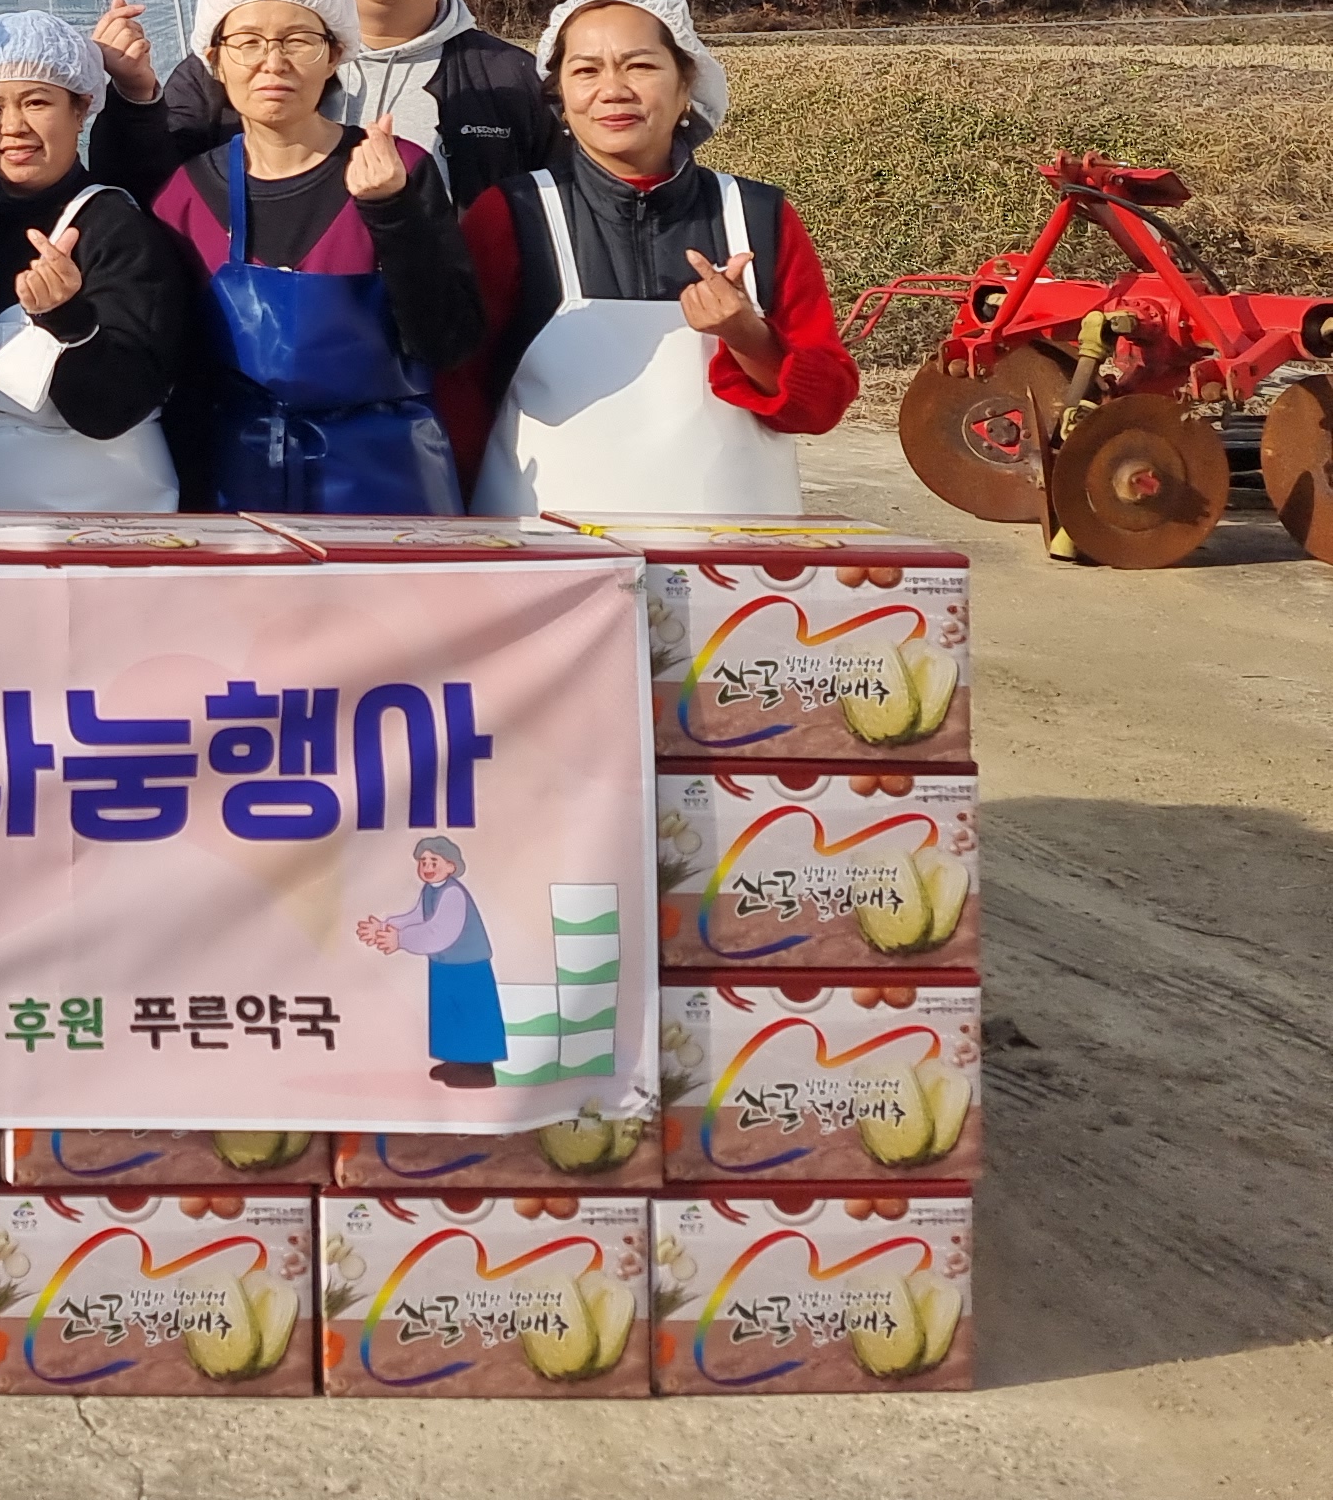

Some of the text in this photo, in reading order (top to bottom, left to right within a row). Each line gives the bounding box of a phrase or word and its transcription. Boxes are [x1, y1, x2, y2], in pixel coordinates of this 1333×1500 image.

[712, 659, 891, 713] 산골 절임배추
[731, 870, 905, 923] 산골 절임배추
[5, 995, 341, 1052] 후원 푸른약국
[733, 1082, 907, 1135] 산골 절임배추
[58, 1293, 233, 1348] 산골 절임배추
[393, 1295, 570, 1349] 산골 절임배추
[726, 1295, 898, 1347] 산골 절임배추
